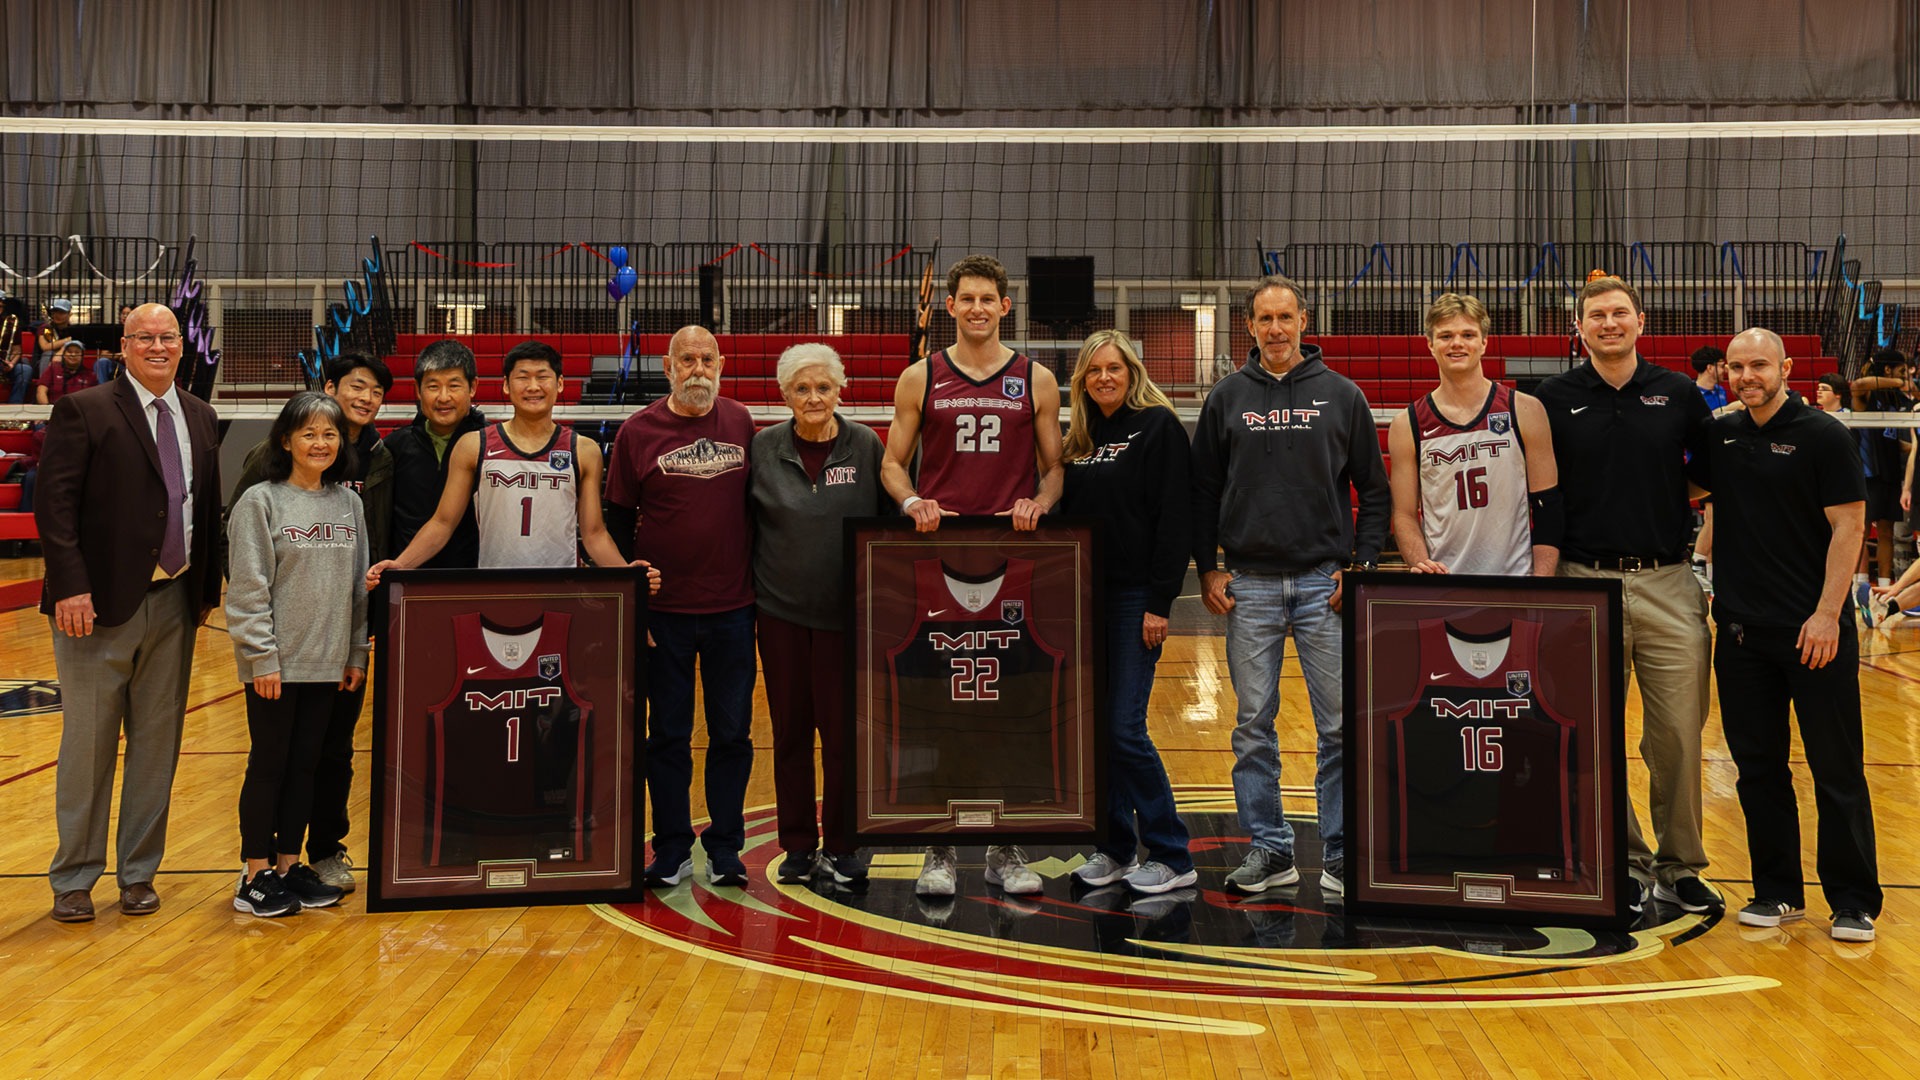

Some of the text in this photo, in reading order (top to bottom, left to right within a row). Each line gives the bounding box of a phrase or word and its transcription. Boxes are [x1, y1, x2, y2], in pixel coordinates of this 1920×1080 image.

[934, 397, 1022, 410] ENGINEERS
[1242, 409, 1320, 426] MIT
[955, 414, 1001, 452] 22
[1426, 439, 1511, 466] MIT
[486, 470, 571, 489] MIT
[825, 466, 857, 486] MIT
[1454, 466, 1489, 511] 16
[520, 496, 533, 537] 1
[281, 523, 358, 542] MIT
[928, 629, 1021, 651] MIT
[950, 657, 1000, 701] 22
[465, 686, 562, 711] MIT
[1430, 697, 1531, 719] MIT
[506, 717, 520, 762] 1
[1460, 726, 1503, 772] 16
